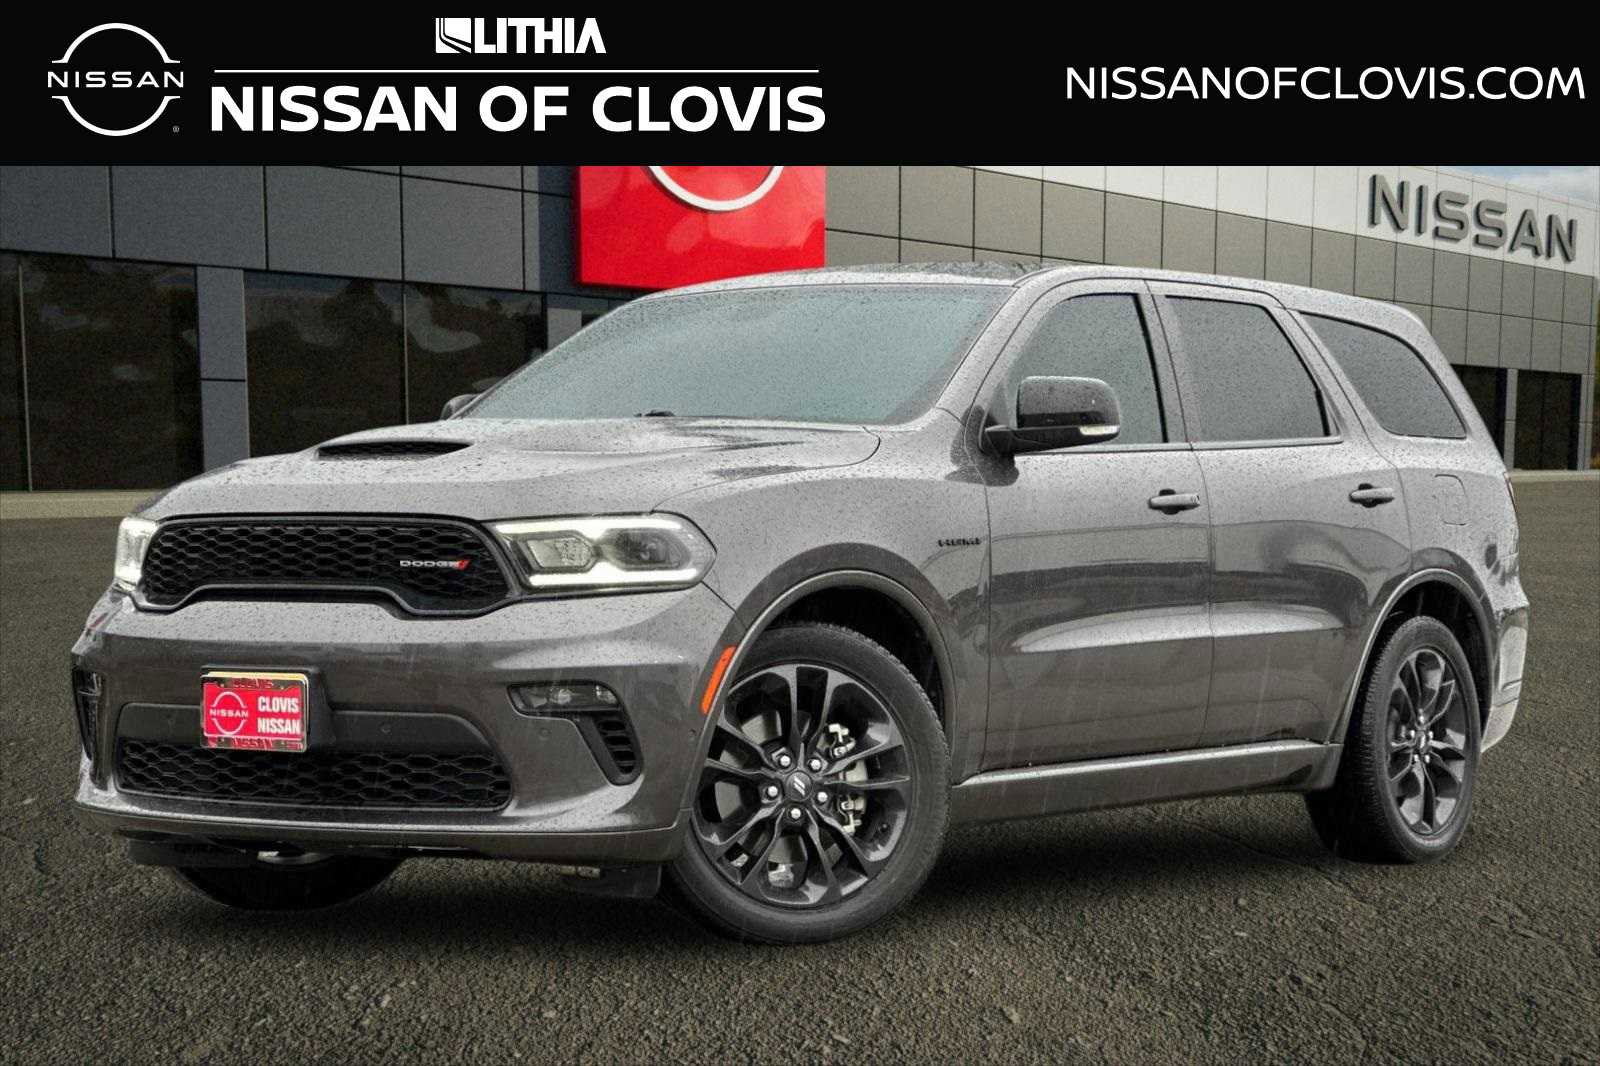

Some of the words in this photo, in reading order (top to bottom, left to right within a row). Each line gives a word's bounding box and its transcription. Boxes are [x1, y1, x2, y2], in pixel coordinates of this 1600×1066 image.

[1368, 174, 1577, 263] NISSAN
[257, 696, 299, 713] CLOVIS
[209, 709, 249, 718] NISSAN
[257, 717, 301, 735] NISSAN
